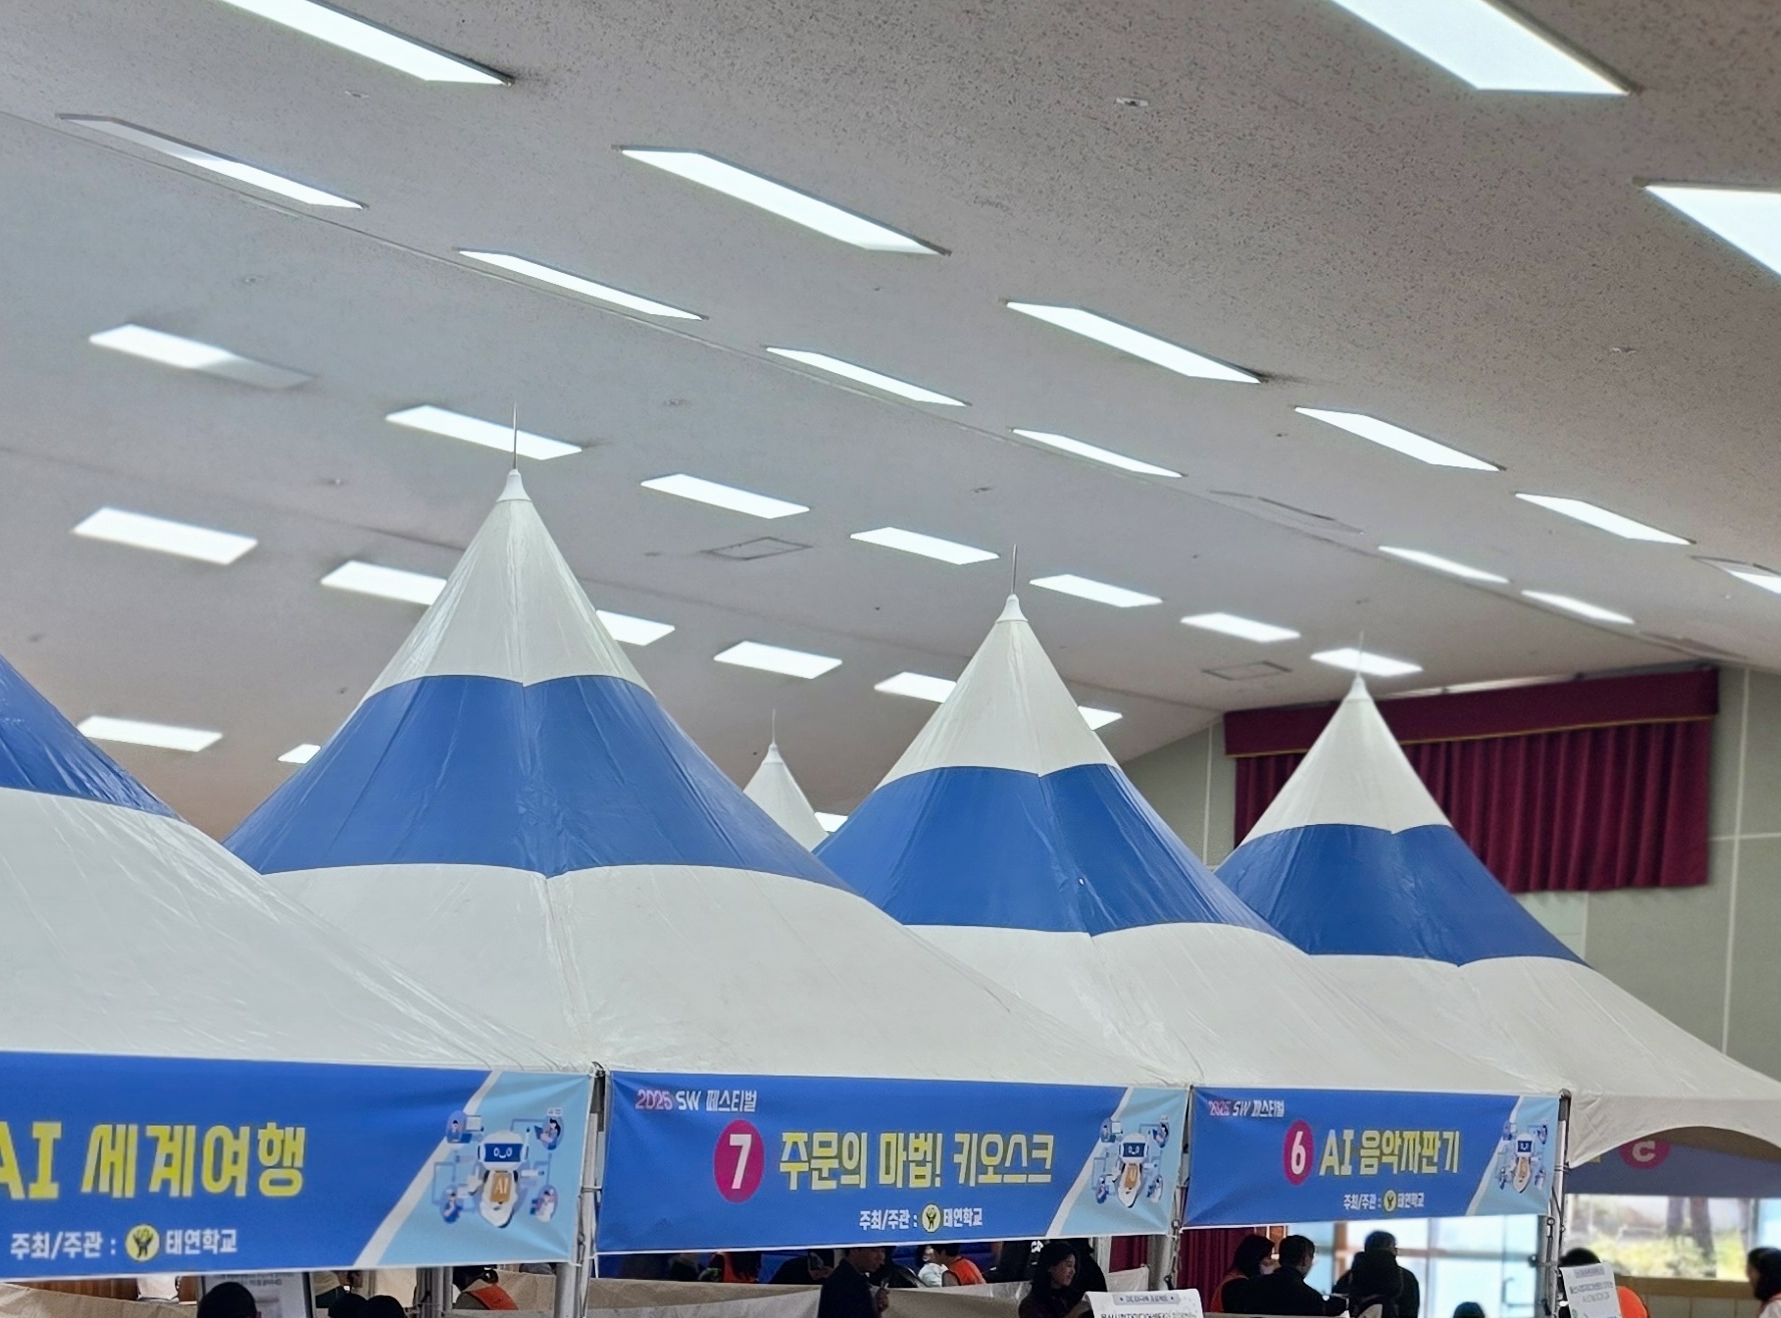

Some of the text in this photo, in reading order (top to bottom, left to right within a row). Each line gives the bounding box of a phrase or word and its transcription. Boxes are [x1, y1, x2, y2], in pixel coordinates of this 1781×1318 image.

[635, 1088, 757, 1113] 2025 SW 페스티벌
[1232, 1100, 1250, 1117] SW
[80, 1122, 306, 1199] 세계여행
[729, 1132, 1054, 1191] 7 주문의 마법! 키오스크
[1290, 1129, 1460, 1177] 6 AI 음악자판기
[495, 1181, 509, 1196] AI
[859, 1209, 910, 1231] 주최/주관
[942, 1207, 983, 1228] 태연학교
[10, 1231, 104, 1260] 주최/주관
[165, 1228, 238, 1255] 태연학교
